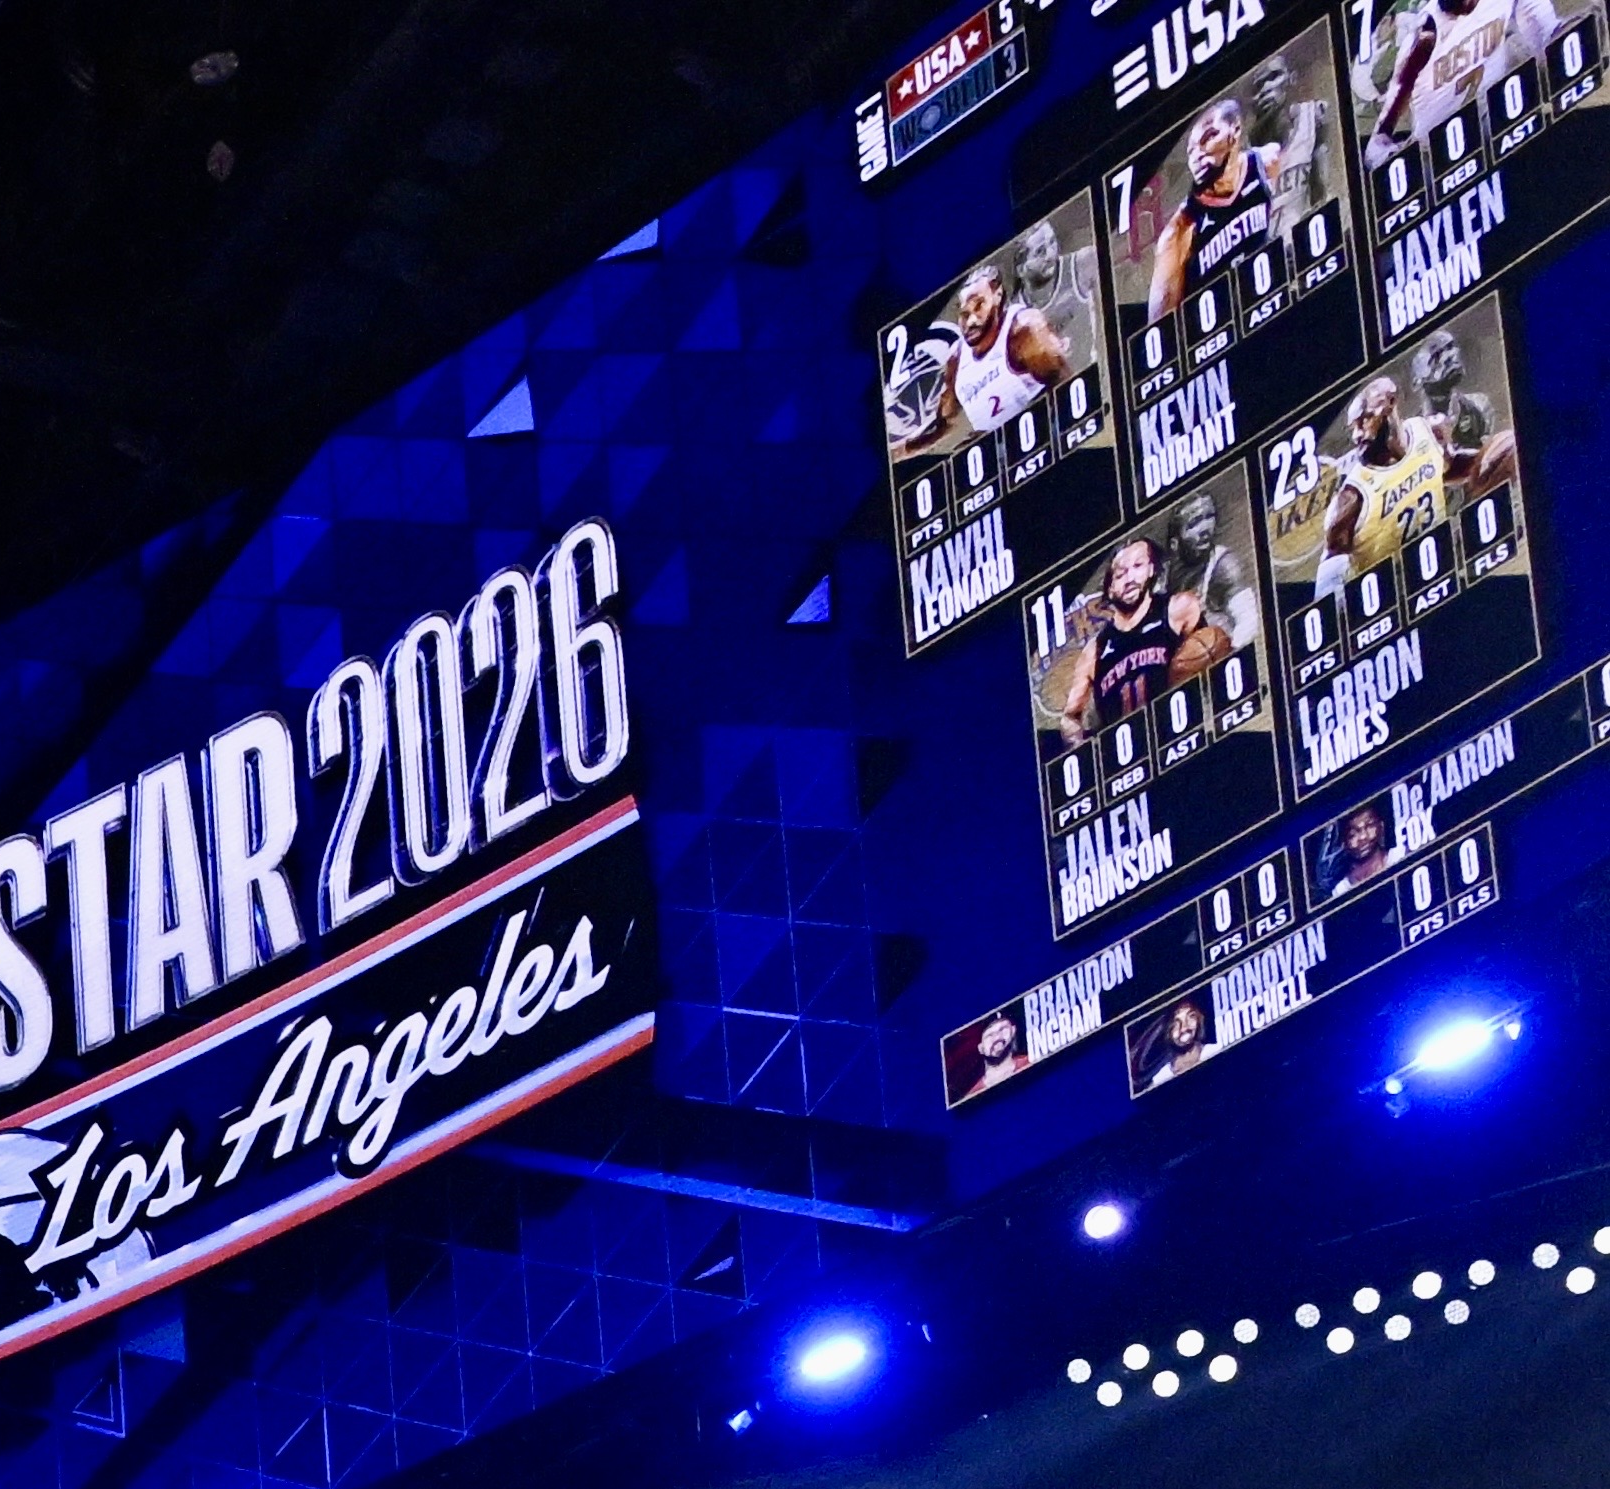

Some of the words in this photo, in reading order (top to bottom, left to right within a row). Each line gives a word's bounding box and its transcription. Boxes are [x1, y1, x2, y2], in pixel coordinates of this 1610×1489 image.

[914, 39, 967, 94] USA
[998, 0, 1014, 34] 5
[1151, 0, 1266, 91] USA
[1352, 0, 1373, 64] 7
[1112, 166, 1135, 234] 7
[1384, 171, 1506, 293] JAYLEN
[1388, 234, 1484, 337] BROWN
[886, 326, 910, 386] 2
[1139, 359, 1232, 456] KEVIN
[1143, 403, 1236, 498] DURANT
[1269, 426, 1319, 511] 23
[909, 506, 1006, 605] KAWHI
[914, 549, 1014, 643] LEONARD
[1031, 585, 1067, 657] 11
[312, 516, 634, 936] 2026
[1299, 628, 1423, 751] LeBRON
[1305, 701, 1389, 785] JAMES
[1058, 791, 1151, 884] JALEN
[1393, 806, 1436, 854] FOX
[1060, 828, 1173, 926] BRUNSON
[1024, 940, 1133, 1027] BRANDON
[1211, 921, 1327, 1016] DONOVAN
[1214, 970, 1313, 1048] MITCHELL
[1026, 991, 1102, 1063] INGRAM
[27, 1120, 198, 1275] Los
[216, 912, 611, 1166] Angeles
